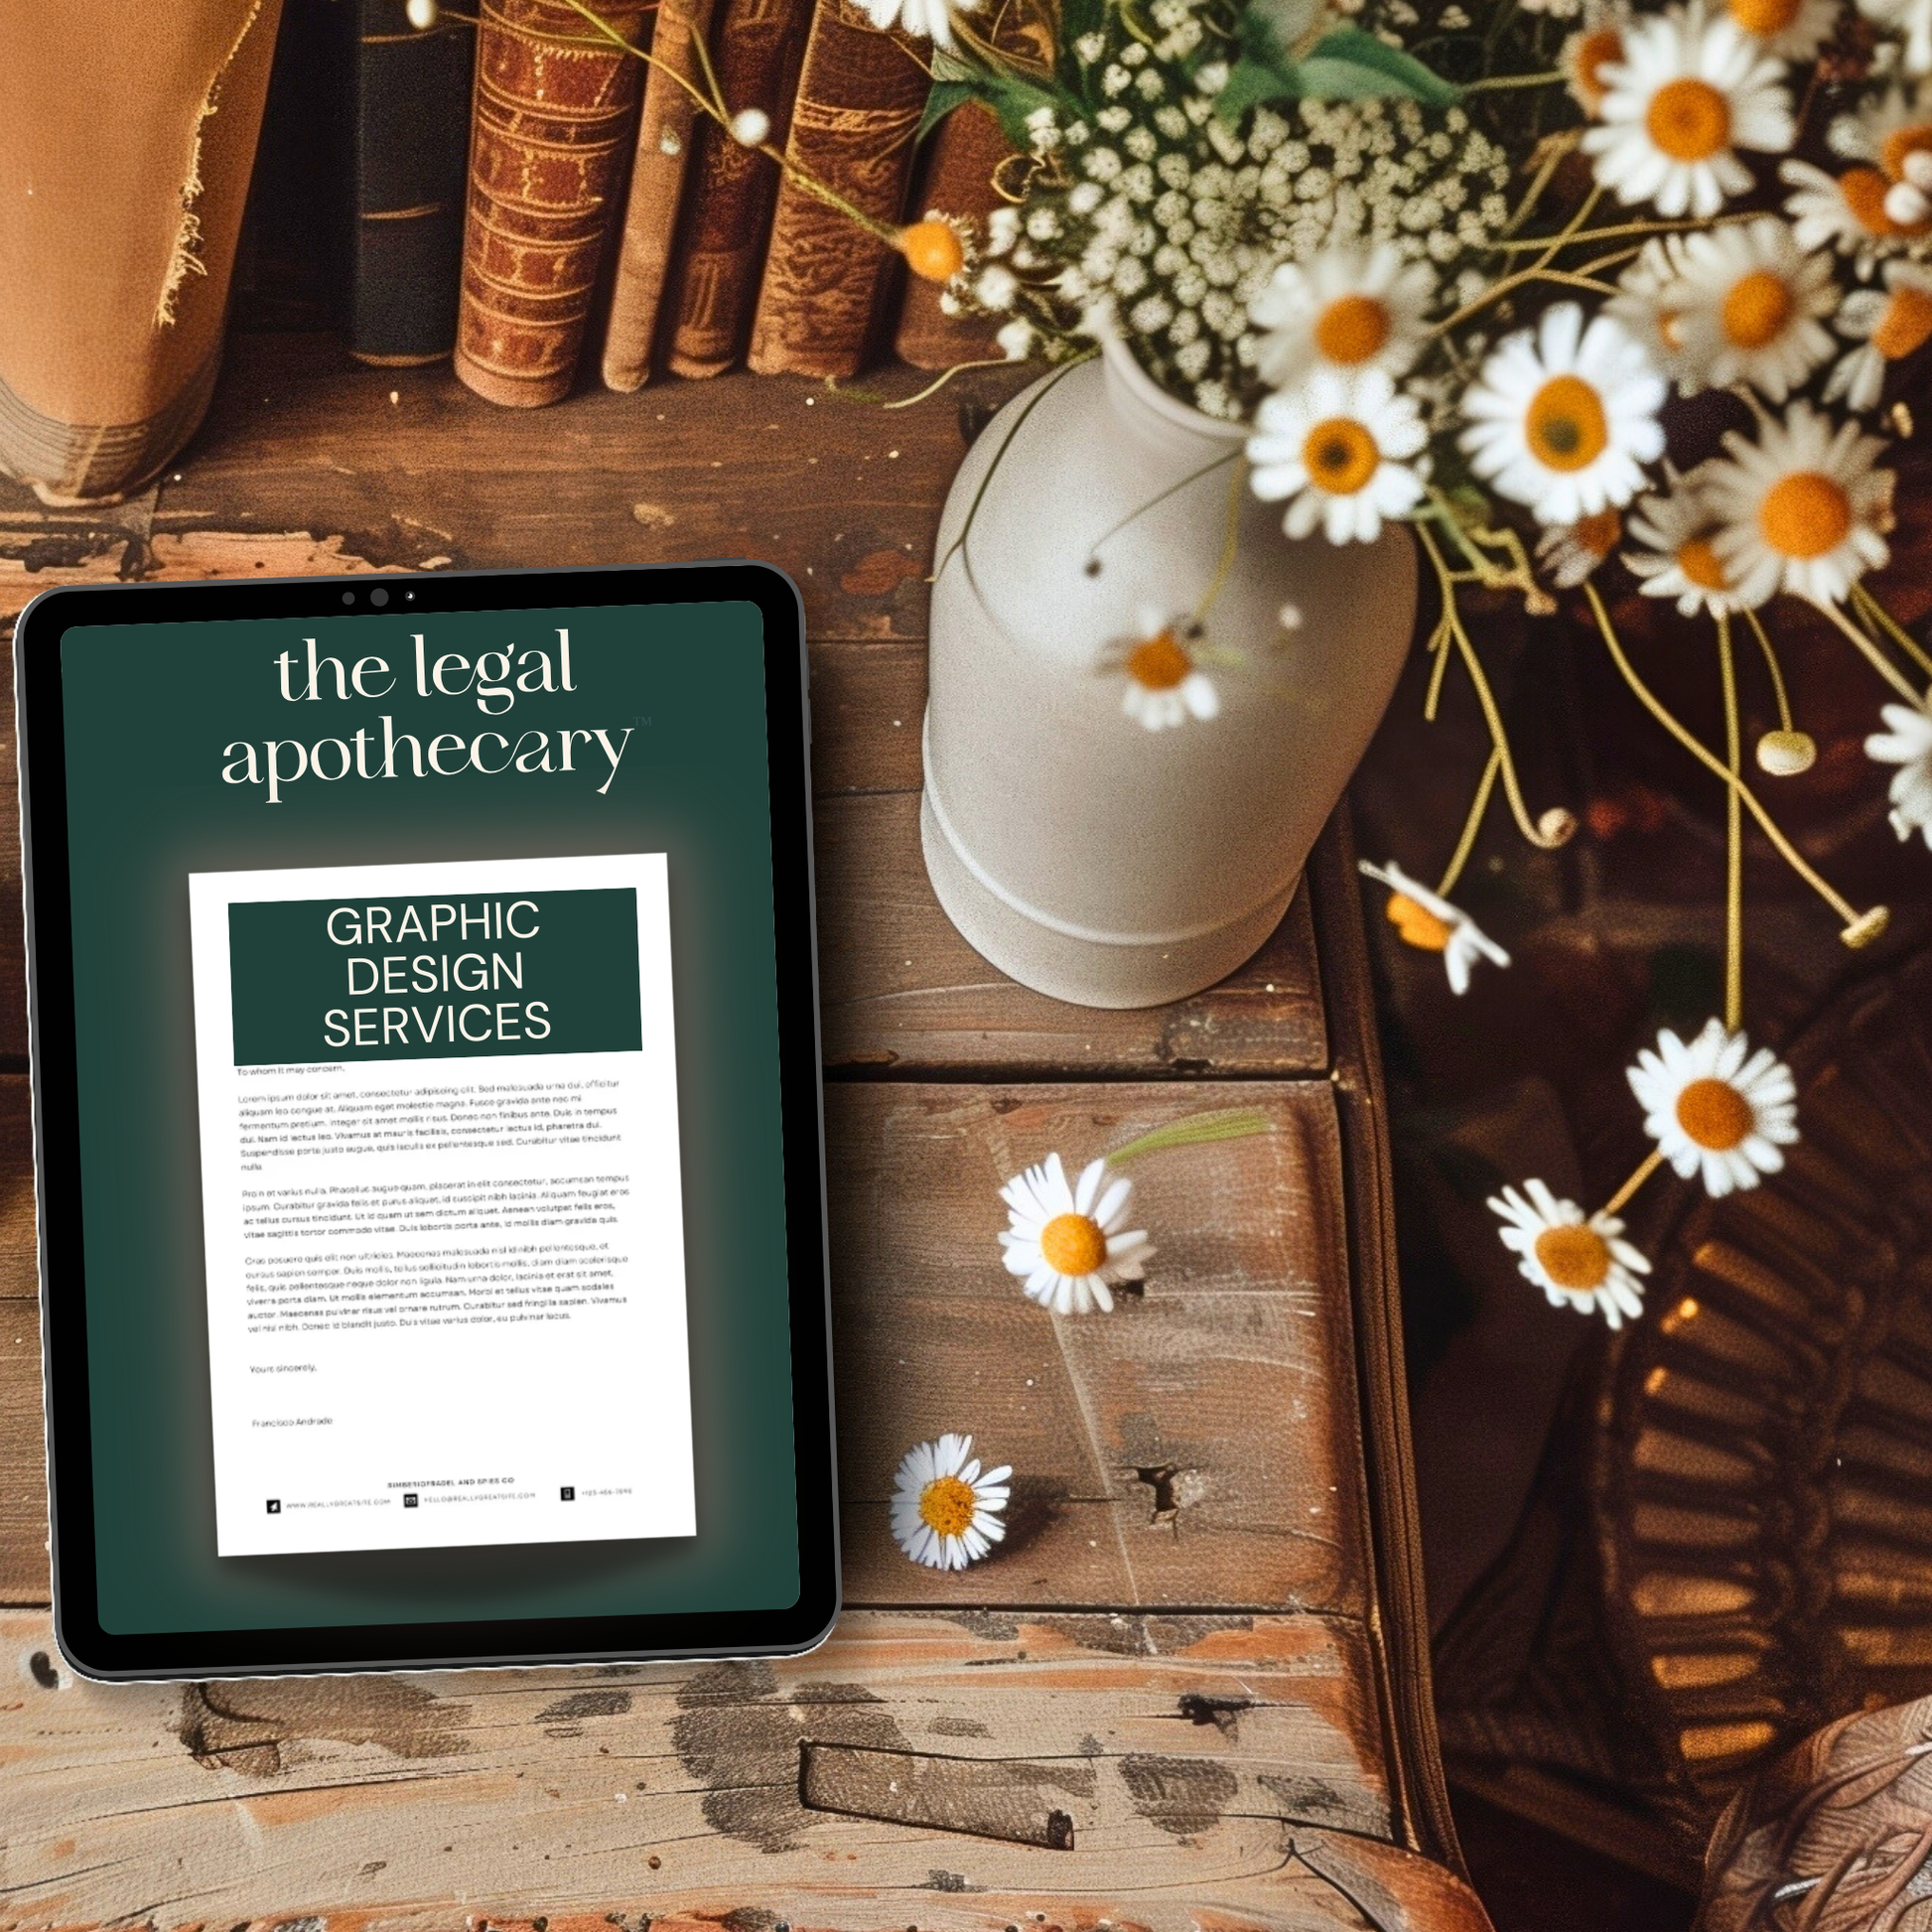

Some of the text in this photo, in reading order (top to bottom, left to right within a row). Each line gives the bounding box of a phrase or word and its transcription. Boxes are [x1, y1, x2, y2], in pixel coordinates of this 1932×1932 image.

[273, 628, 578, 716] the legal
[221, 716, 635, 804] apothecary
[326, 899, 541, 946] GRAPHIC
[347, 951, 523, 996] DESIGN
[323, 1001, 552, 1047] SERVICES
